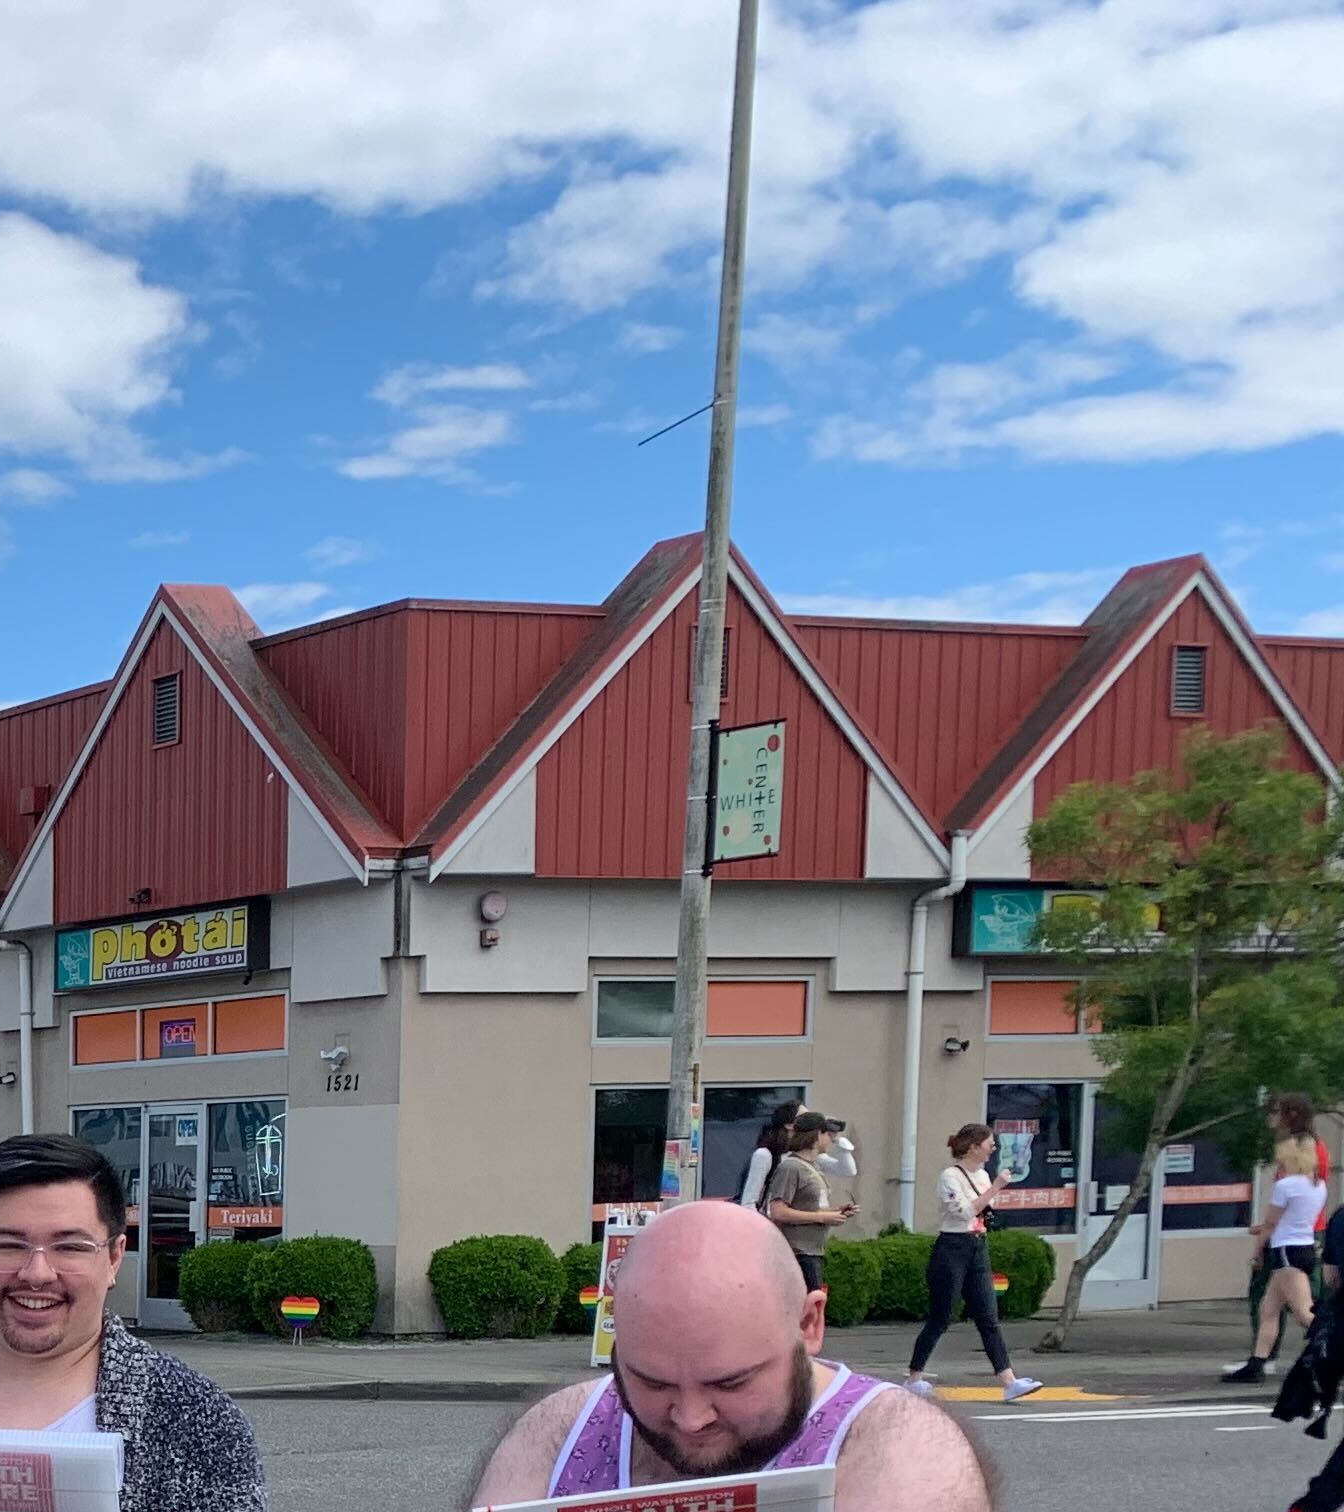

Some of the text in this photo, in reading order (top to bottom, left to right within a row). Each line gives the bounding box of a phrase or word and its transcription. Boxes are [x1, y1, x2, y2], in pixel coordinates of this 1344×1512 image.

[720, 789, 776, 811] WHITE
[752, 747, 768, 834] CENTER
[107, 952, 243, 979] Vietnamese noodle soup
[165, 1025, 196, 1043] OPEN
[327, 1073, 359, 1092] 1521
[178, 1119, 198, 1137] OPEN
[221, 1209, 273, 1226] Teriyaki
[637, 1490, 736, 1509] WASHINGTON
